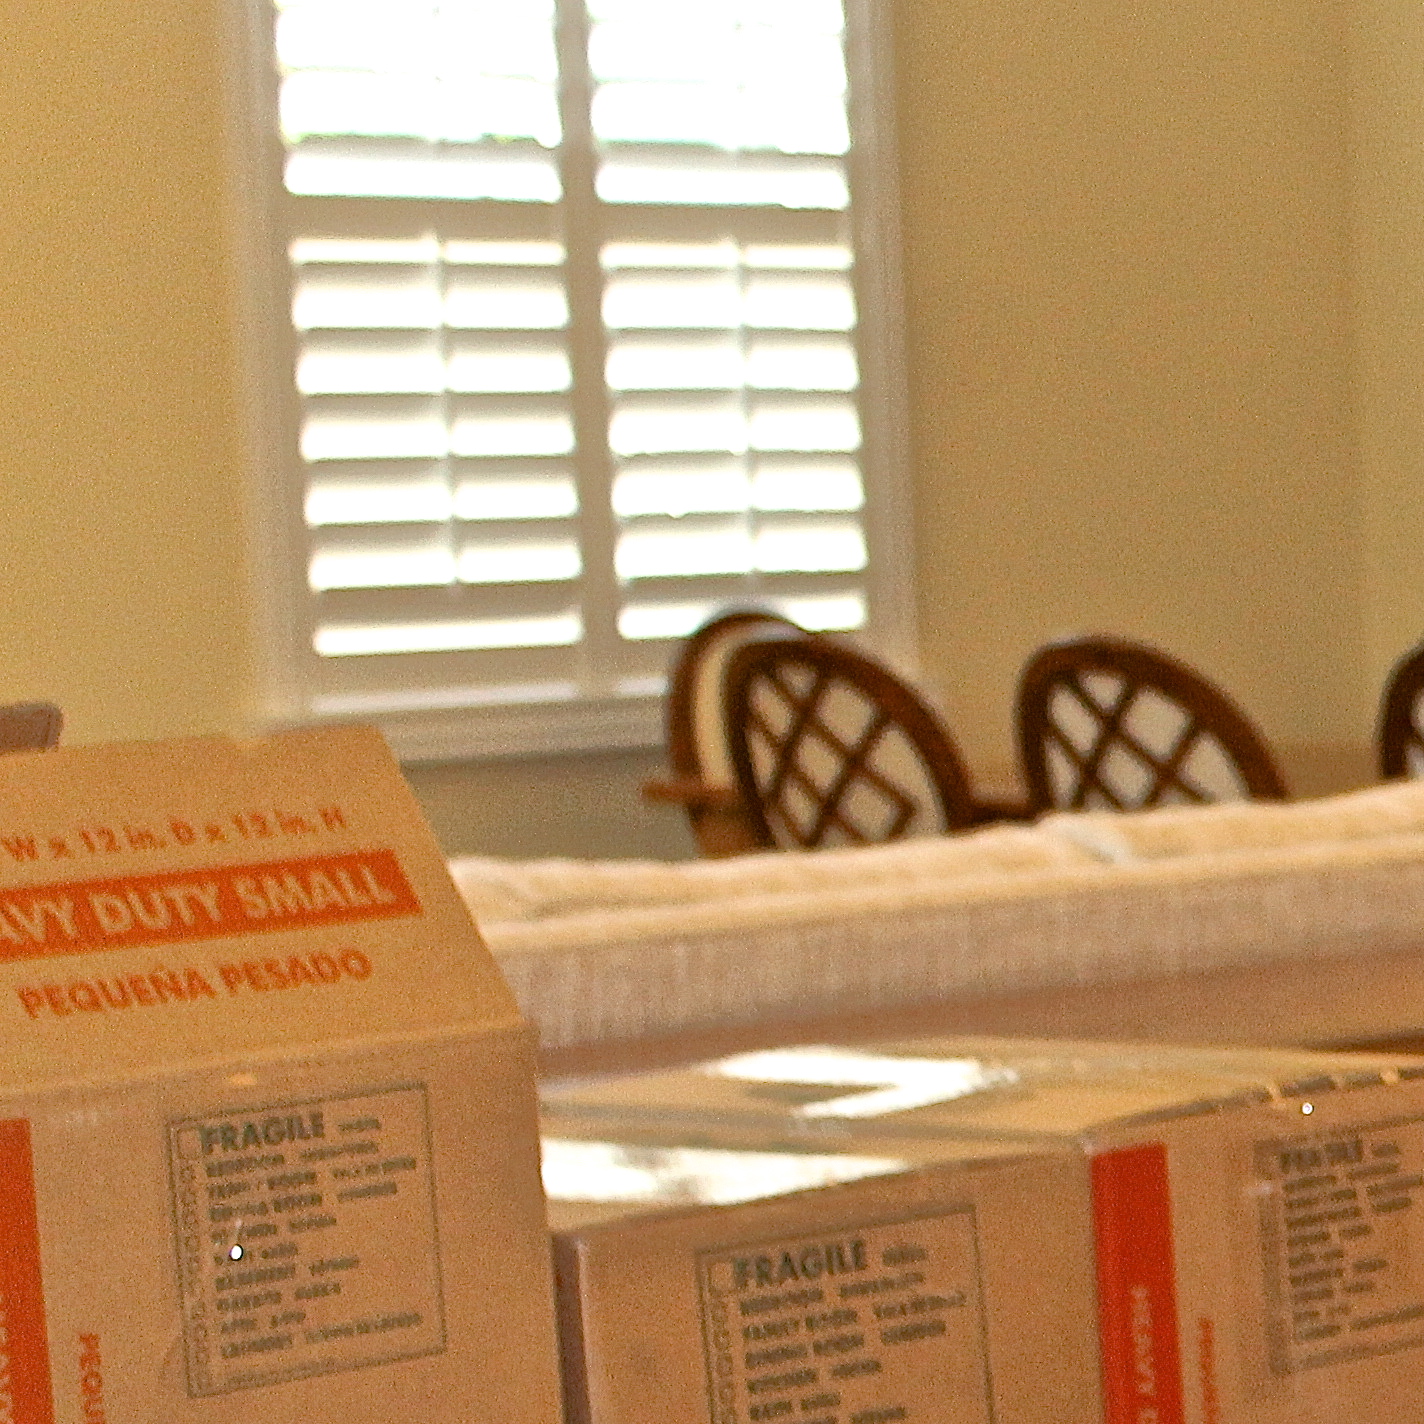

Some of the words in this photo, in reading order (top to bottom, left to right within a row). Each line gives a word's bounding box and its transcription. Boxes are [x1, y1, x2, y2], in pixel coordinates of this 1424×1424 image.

[1, 834, 38, 862] W
[0, 897, 78, 945] AVY
[89, 882, 223, 934] DUTY
[232, 864, 394, 920] SMALL
[219, 947, 373, 994] PESADO
[199, 1111, 325, 1155] FRAGILE
[733, 1238, 867, 1289] FRAGILE
